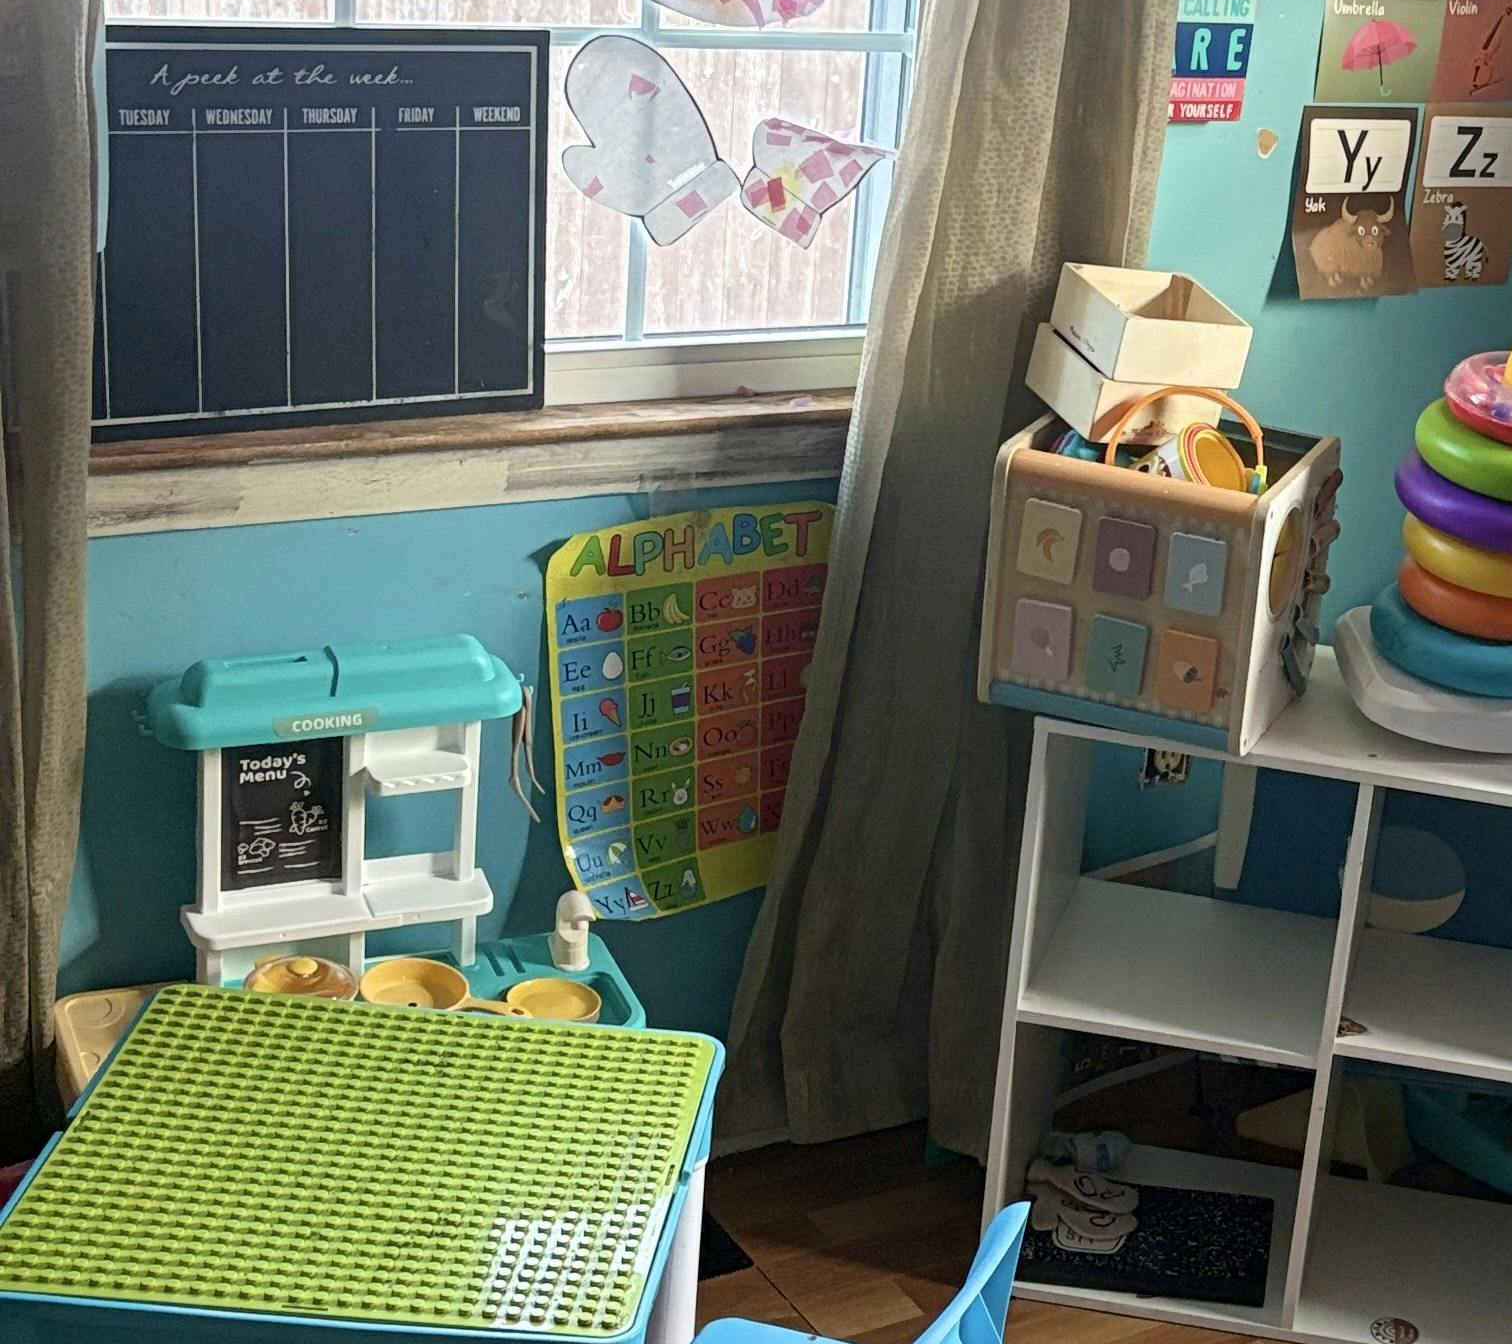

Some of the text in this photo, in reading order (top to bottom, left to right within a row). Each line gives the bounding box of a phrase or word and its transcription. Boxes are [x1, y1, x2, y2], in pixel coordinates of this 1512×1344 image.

[150, 64, 171, 86] A
[171, 66, 240, 95] peek
[252, 68, 285, 86] at
[294, 65, 338, 86] the
[119, 106, 521, 126] TUESDAY WEDNESDAY THURSDAY FRIDAY WEEKEND
[1179, 103, 1233, 119] YOURSELF
[1337, 129, 1383, 191] Yy
[1449, 125, 1498, 179] Zz
[1304, 197, 1327, 215] Yak
[1423, 188, 1454, 206] Zebra
[570, 509, 823, 577] ALPHABET
[700, 592, 732, 611] Cc
[631, 602, 661, 624] Bb
[562, 614, 591, 636] Aa
[700, 636, 730, 656] Gg
[631, 646, 656, 670] Ff
[563, 661, 592, 683] Ee
[703, 681, 733, 704] Kk
[638, 693, 655, 718] Jj
[291, 713, 363, 732] COOKING
[573, 713, 589, 732] Ii
[704, 727, 736, 746] Oo
[239, 753, 306, 771] Today's
[634, 745, 666, 763] Nn
[239, 769, 287, 784] Menu
[566, 760, 602, 780] Mm
[704, 775, 723, 794] Ss
[641, 788, 671, 807] Rr
[568, 805, 597, 823] Qq
[637, 834, 668, 855] Vv
[576, 855, 603, 872] Uu
[648, 880, 675, 901] Zz
[594, 896, 626, 915] Yy
